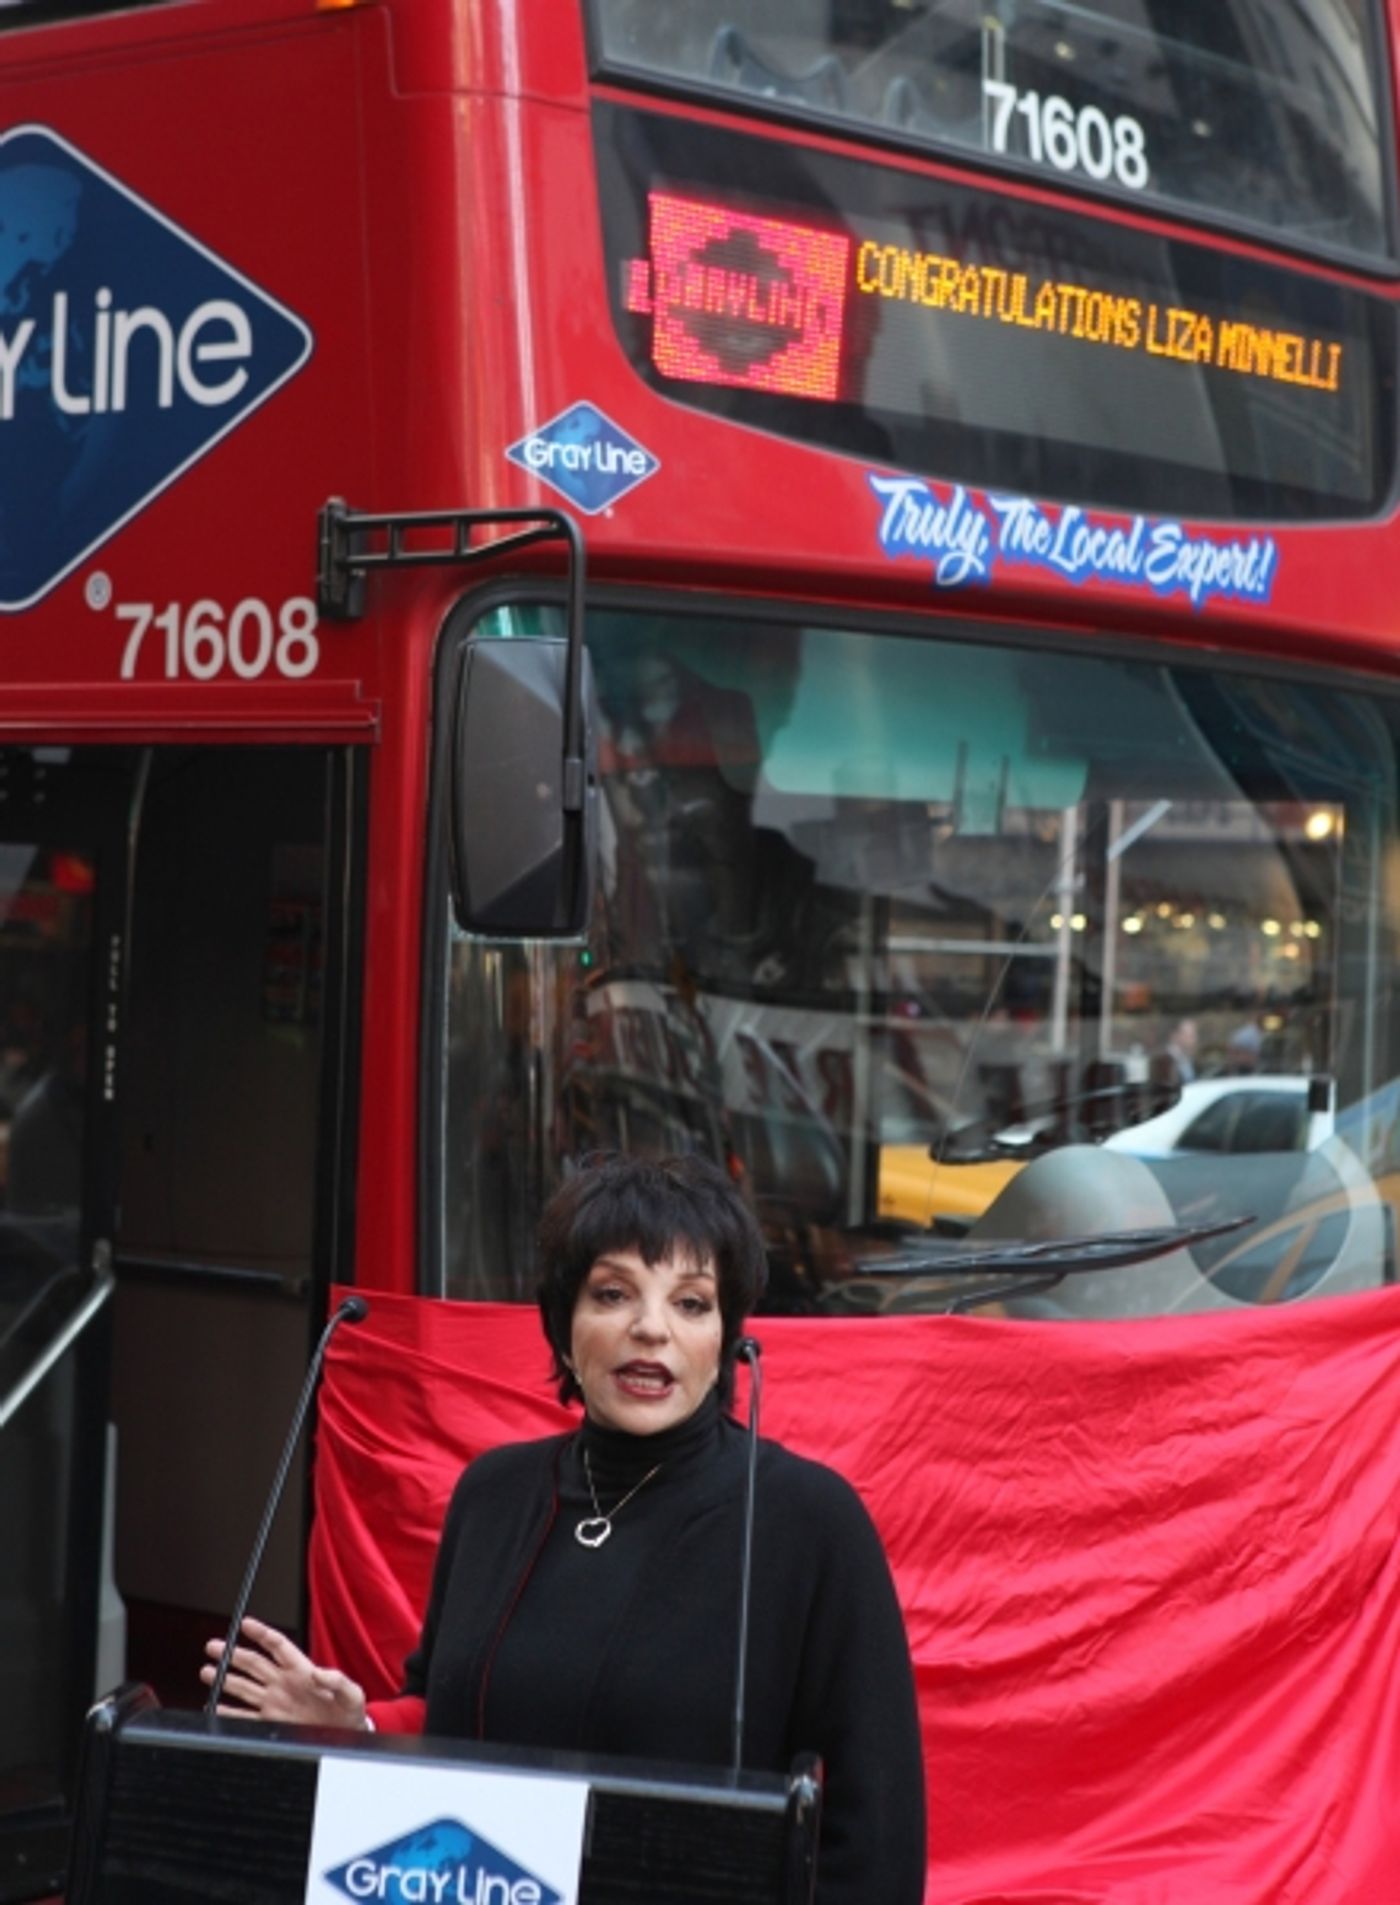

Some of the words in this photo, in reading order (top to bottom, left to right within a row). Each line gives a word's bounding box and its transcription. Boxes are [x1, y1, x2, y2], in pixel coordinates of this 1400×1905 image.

[981, 78, 1149, 190] 71608
[51, 286, 253, 415] Line
[856, 240, 1141, 349] CONGRATULATIONS
[1145, 303, 1213, 364] LIZA
[1216, 320, 1343, 391] MINNELLI
[868, 473, 990, 587] Truly,
[989, 494, 1051, 555] The
[1049, 505, 1145, 574] Local
[1143, 522, 1275, 602] Expert!
[115, 597, 320, 680] 71608
